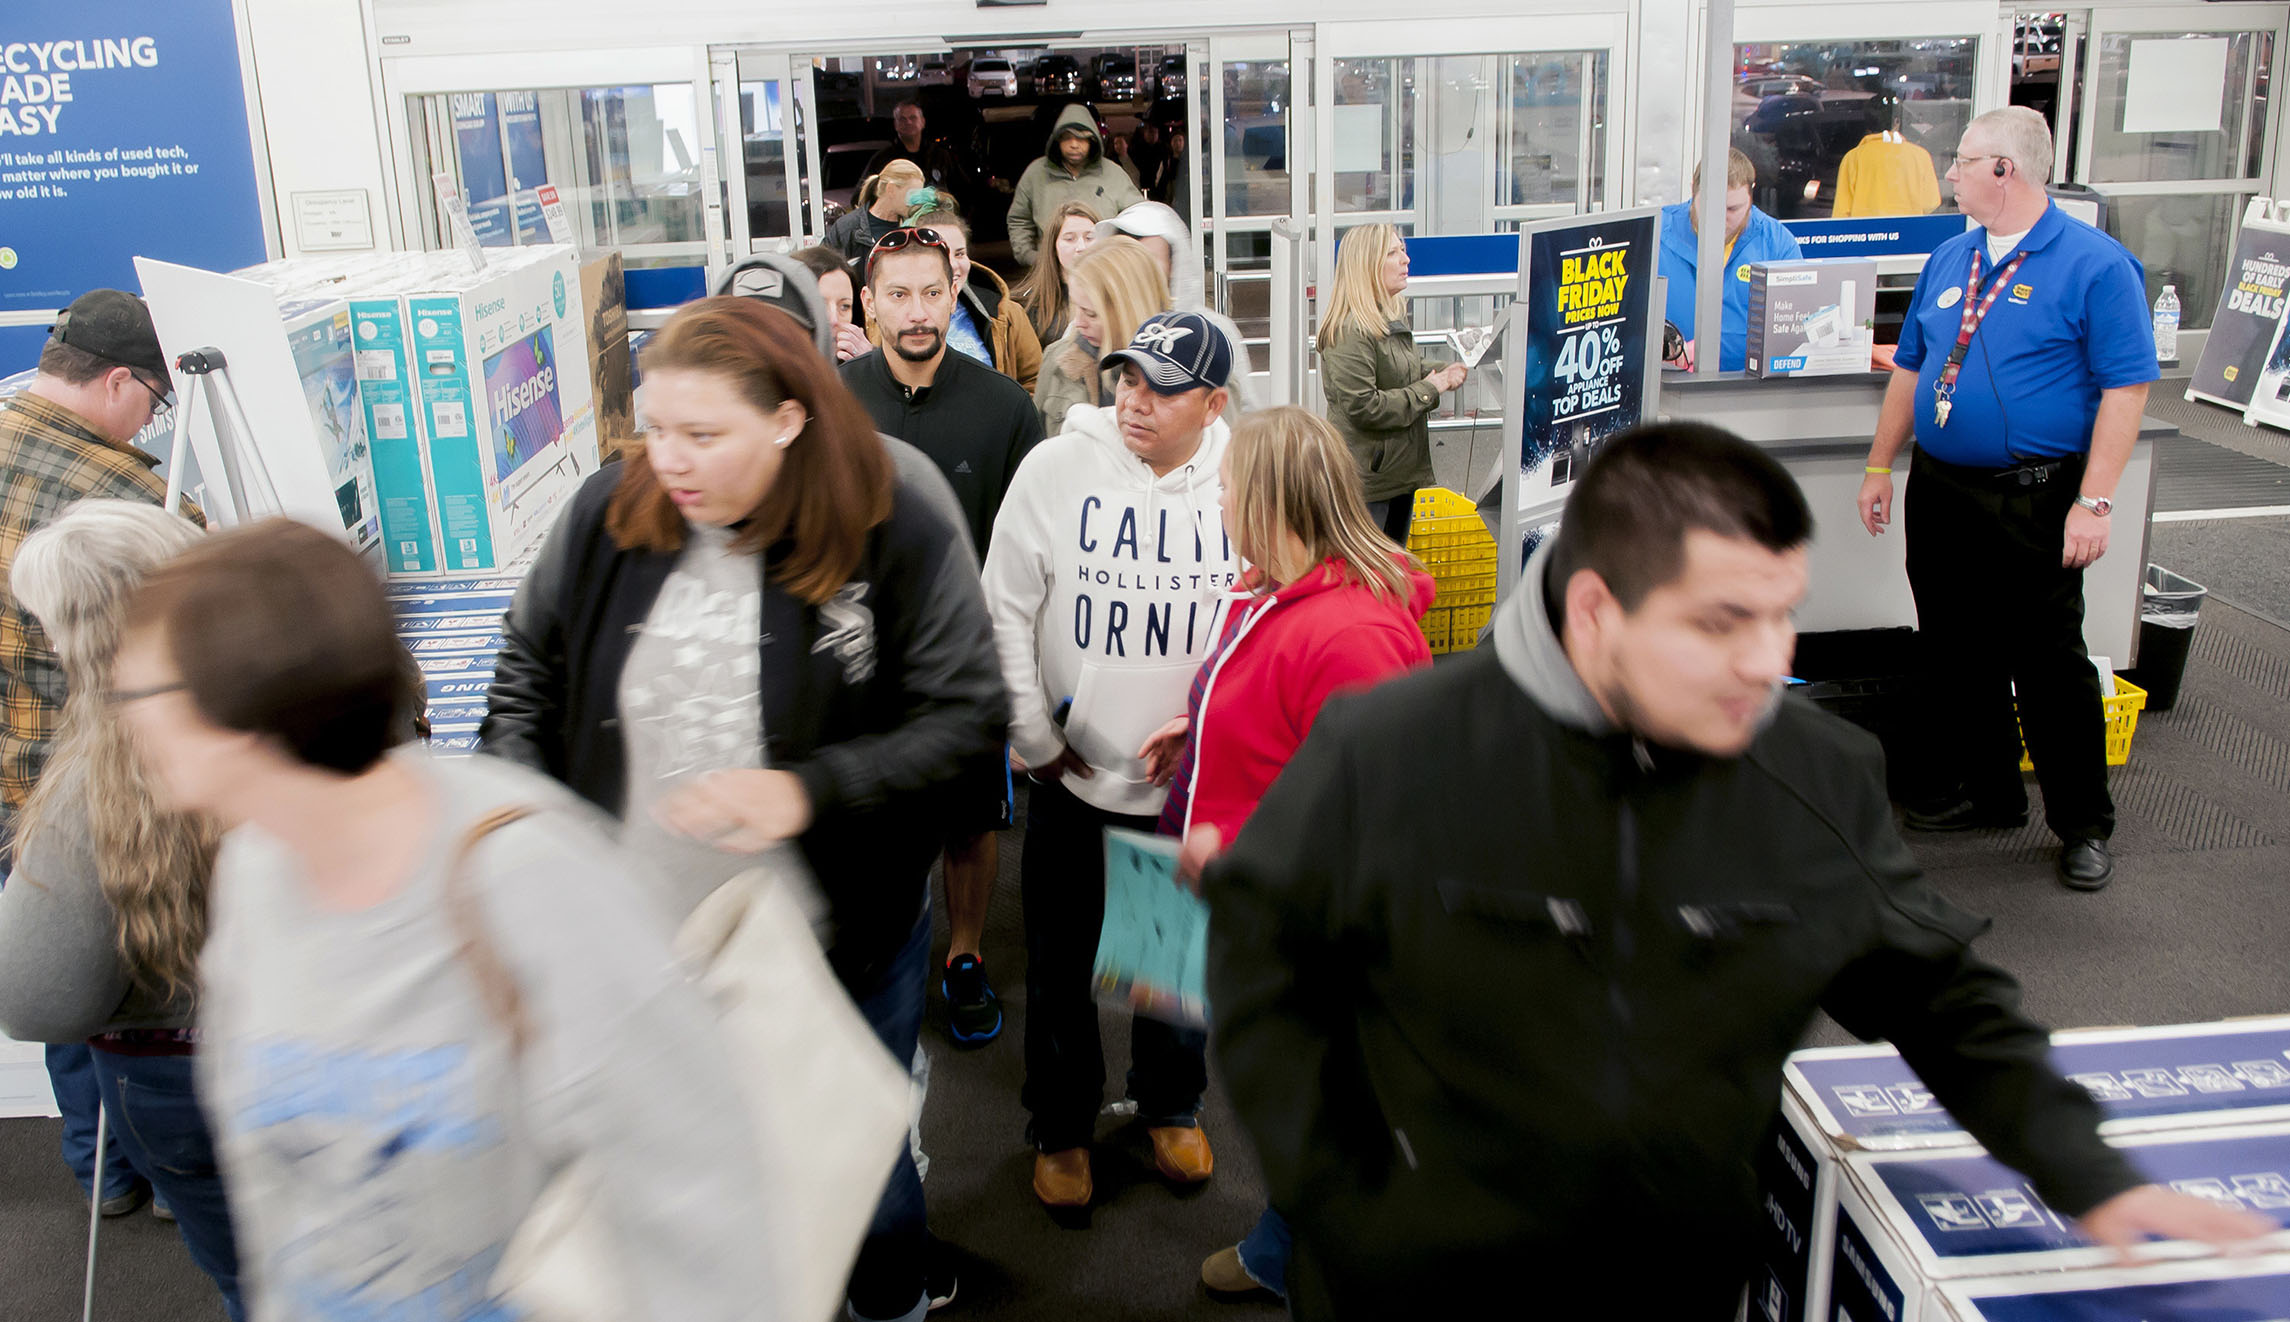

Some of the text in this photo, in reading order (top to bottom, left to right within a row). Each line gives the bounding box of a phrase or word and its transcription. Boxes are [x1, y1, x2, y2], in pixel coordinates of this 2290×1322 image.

[1, 73, 73, 105] ADE
[454, 92, 485, 118] SMART
[0, 104, 62, 136] ASY
[15, 152, 44, 166] take
[47, 150, 63, 164] all
[65, 149, 102, 164] kinds
[104, 147, 119, 161] of
[121, 145, 153, 160] used
[155, 144, 188, 160] tech,
[2, 161, 200, 183] matter where you bought it or
[16, 184, 38, 199] old
[40, 184, 51, 198] it
[52, 184, 68, 197] is.
[1811, 235, 1827, 244] FOR
[1828, 234, 1866, 243] SHOPPING
[1867, 233, 1888, 241] WITH
[1889, 232, 1899, 240] US
[1562, 250, 1626, 285] BLACK
[2241, 259, 2290, 279] HUNDREDS
[2238, 281, 2258, 293] BLACK
[2242, 271, 2285, 288] OF EARLY
[1558, 274, 1629, 312] FRIDAY
[2227, 288, 2285, 320] DEALS
[417, 309, 453, 317] Hisense
[475, 298, 505, 322] Hisense
[1565, 302, 1620, 324] PRICES NOW
[1773, 312, 1794, 322] Home
[1774, 301, 1793, 311] Make
[1773, 323, 1790, 334] Safe
[1554, 325, 1621, 384] 40%
[1773, 359, 1802, 370] DEFEND
[1600, 355, 1624, 377] OFF
[494, 366, 554, 426] Hisense
[1567, 376, 1609, 395] APPLIANCE
[1552, 384, 1622, 416] TOP DEALS
[1080, 496, 1229, 563] CALI
[1079, 565, 1235, 590] HOLLISTER
[1075, 594, 1221, 657] ORNI
[1842, 1234, 1896, 1322] SAMSUNG
